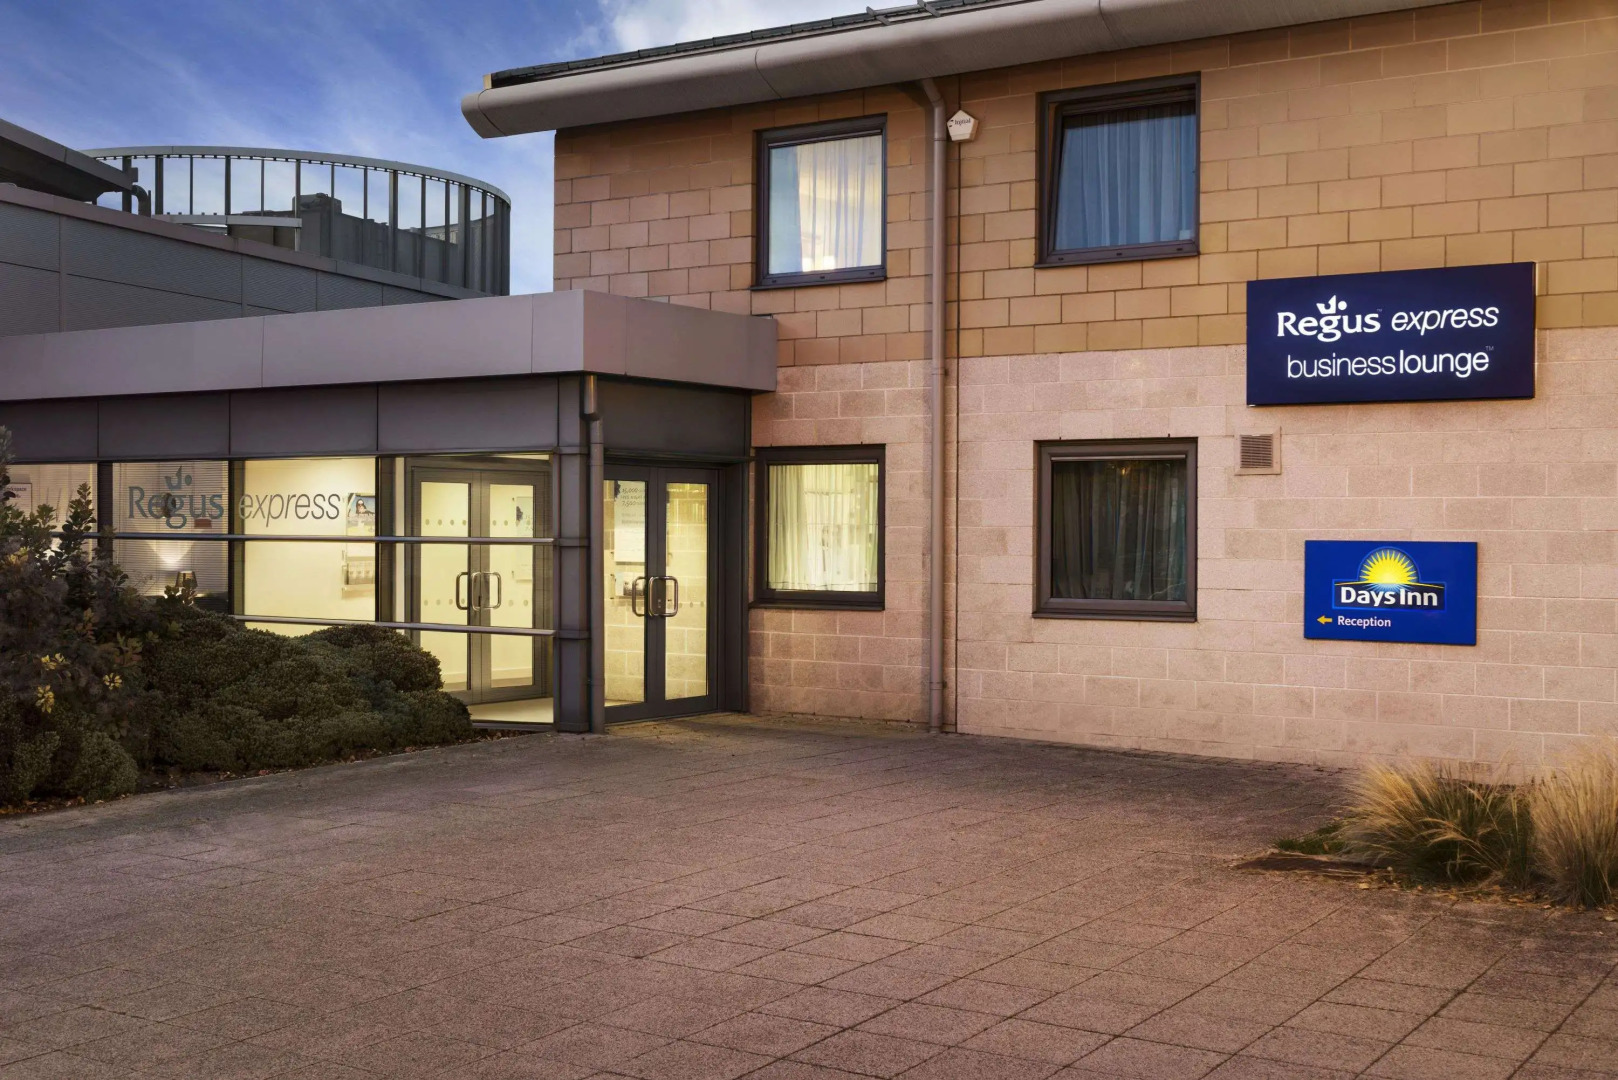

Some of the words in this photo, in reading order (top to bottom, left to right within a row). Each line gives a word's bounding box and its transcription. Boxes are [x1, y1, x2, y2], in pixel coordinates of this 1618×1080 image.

[1277, 312, 1381, 342] Regus
[1391, 307, 1499, 336] express
[1287, 352, 1396, 378] business
[1399, 349, 1490, 378] lounge
[128, 486, 225, 529] Regus
[238, 492, 342, 528] express
[1340, 586, 1396, 607] Days
[1399, 588, 1438, 606] Inn
[1337, 615, 1391, 629] Reception
